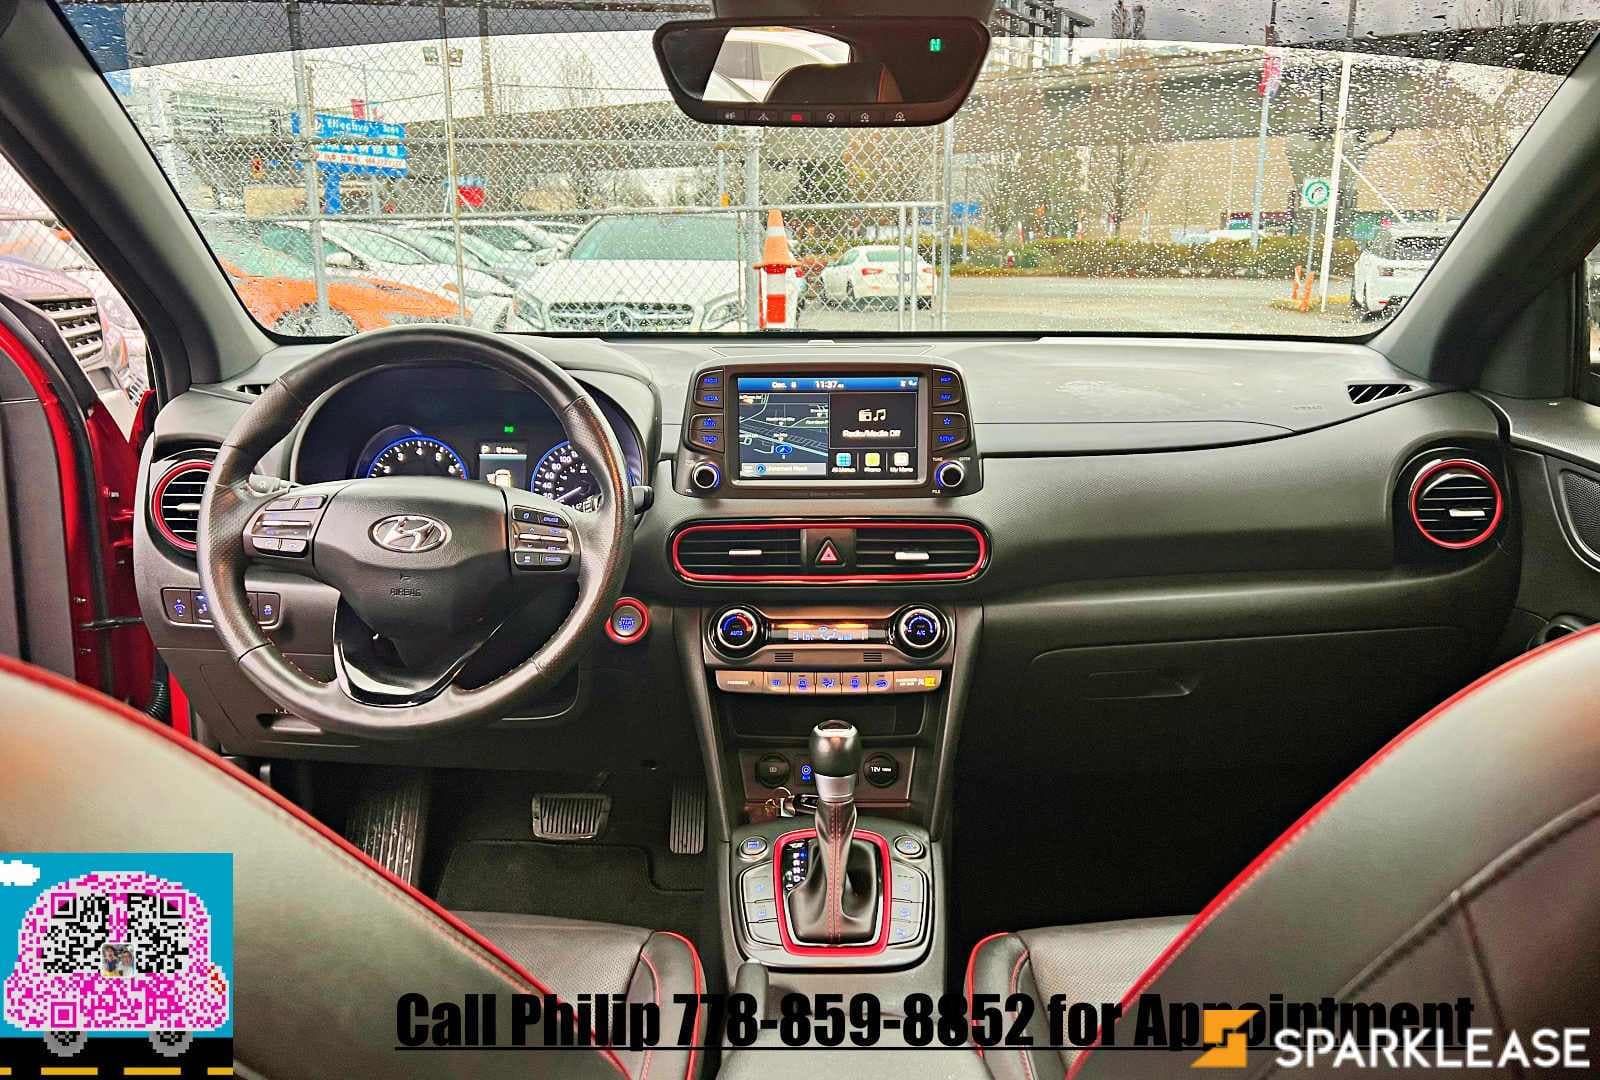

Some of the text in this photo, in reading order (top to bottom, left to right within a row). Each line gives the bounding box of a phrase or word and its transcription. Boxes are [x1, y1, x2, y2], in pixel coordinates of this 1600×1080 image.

[929, 38, 942, 52] N
[415, 447, 423, 456] 4
[397, 452, 404, 461] 3
[383, 465, 391, 474] 2
[551, 463, 562, 471] 80
[544, 471, 555, 480] 60
